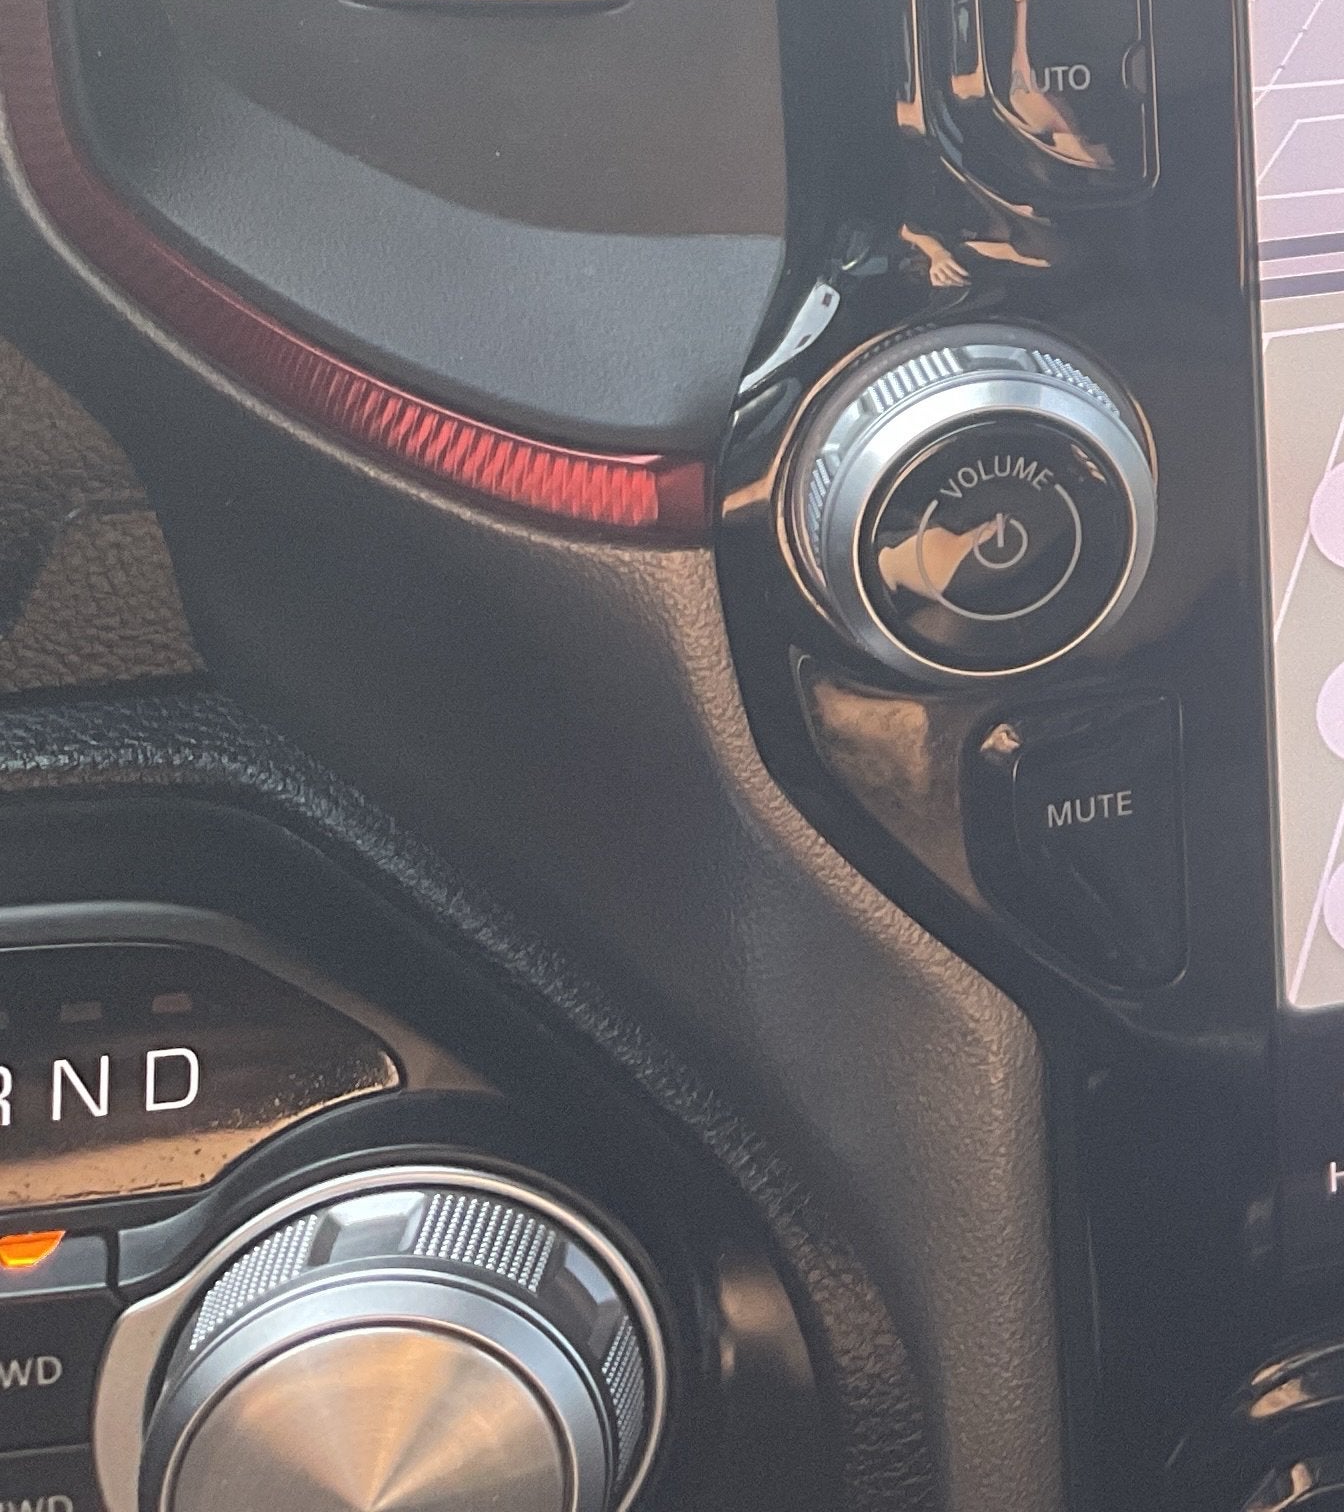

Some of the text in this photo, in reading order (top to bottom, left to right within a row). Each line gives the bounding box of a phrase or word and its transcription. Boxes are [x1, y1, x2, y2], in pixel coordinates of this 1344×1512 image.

[940, 454, 1056, 502] VOLUME
[1046, 790, 1134, 830] MUTE
[0, 1355, 63, 1388] WD
